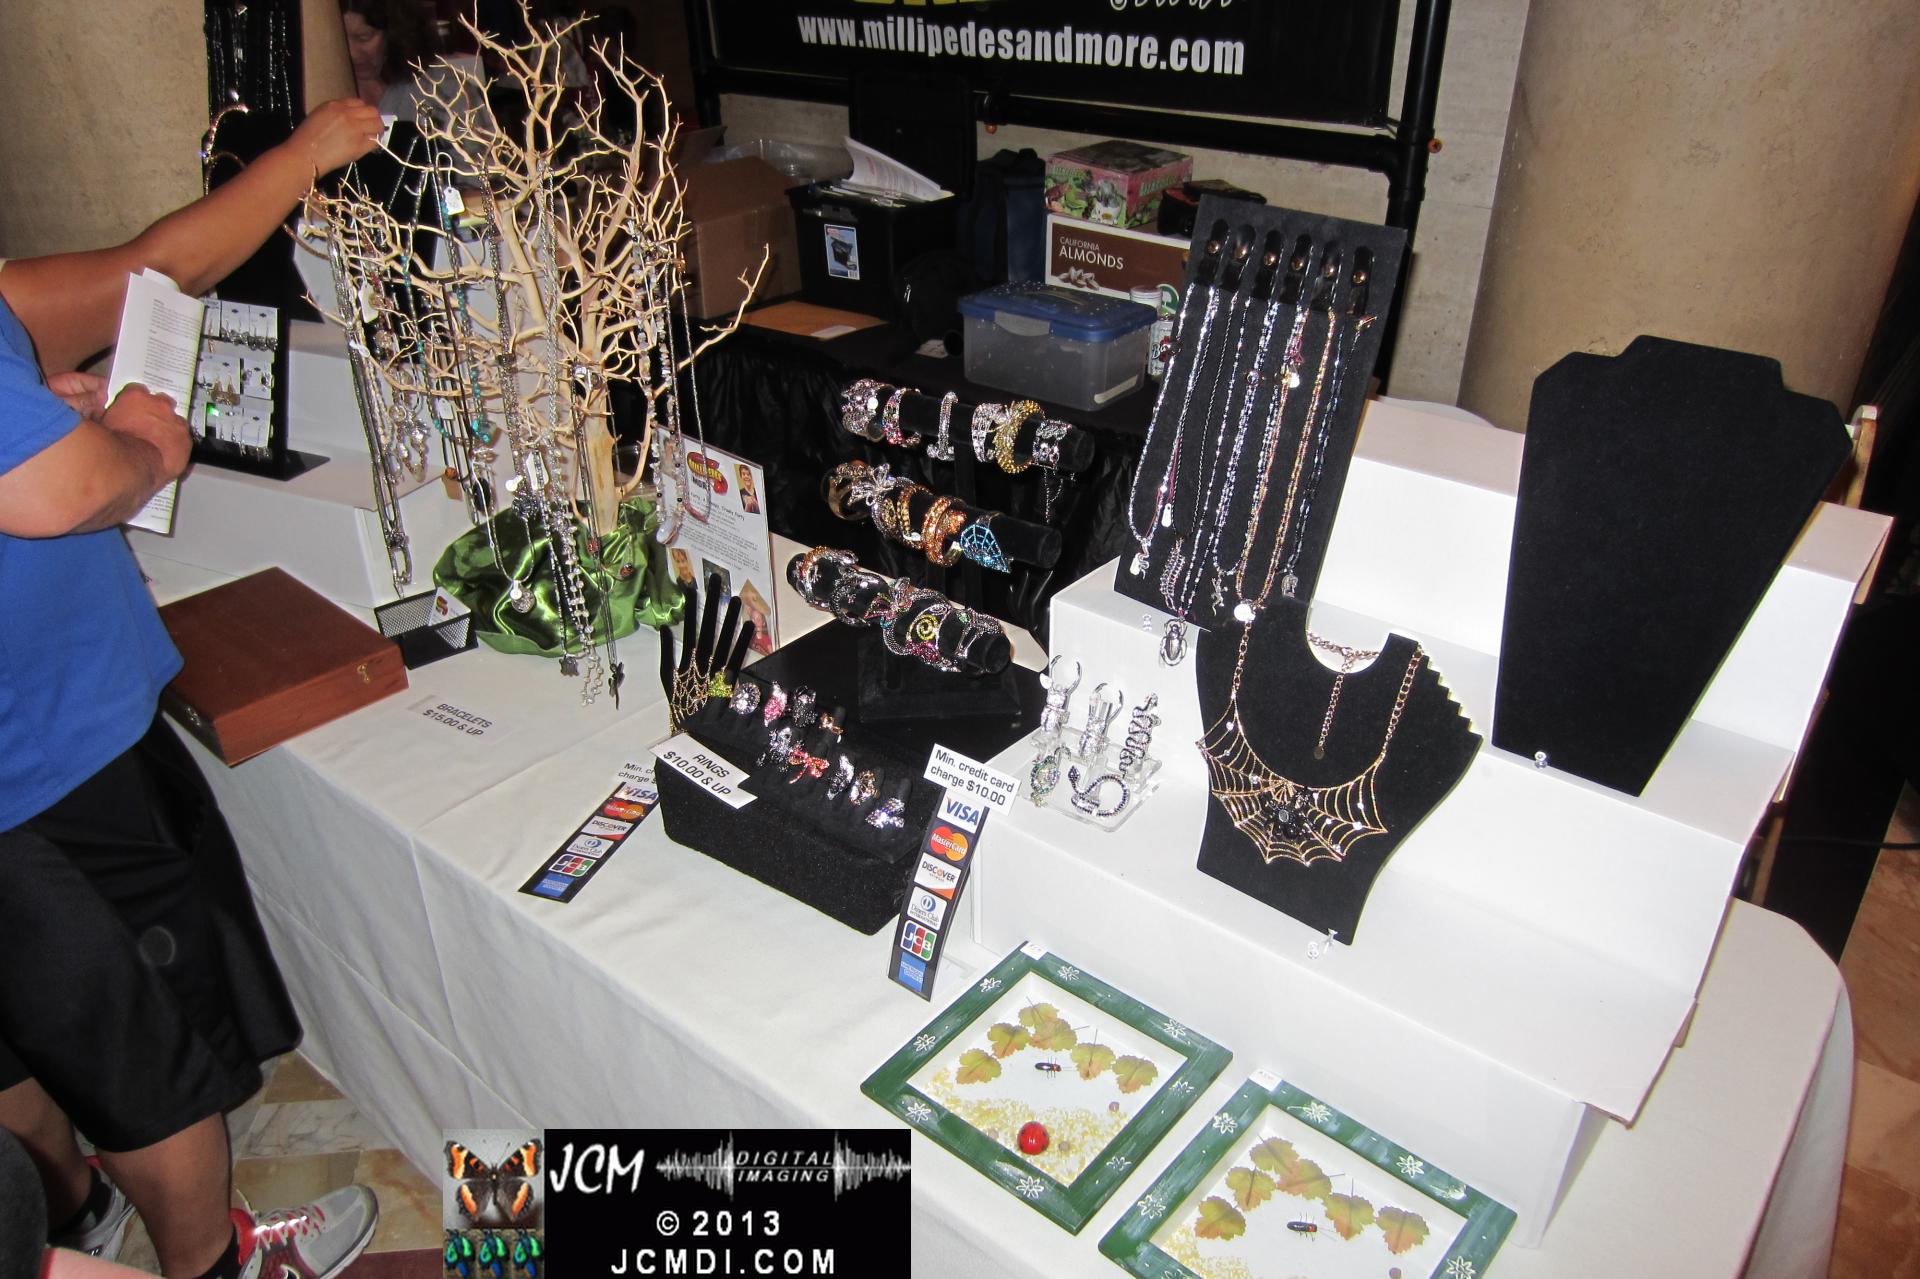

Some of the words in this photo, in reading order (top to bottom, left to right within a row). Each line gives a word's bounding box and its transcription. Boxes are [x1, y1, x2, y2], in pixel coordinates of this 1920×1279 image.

[797, 14, 1246, 76] www.millipedesandmore.com
[1059, 236, 1100, 251] CALIFORNIA
[1058, 245, 1125, 270] ALMONDS
[423, 709, 459, 727] $15.00
[457, 723, 467, 731] &
[466, 727, 484, 736] UP
[436, 703, 493, 729] BRACELETS
[618, 771, 650, 783] charge
[623, 762, 643, 773] Min.
[663, 750, 703, 780] $10.00
[700, 776, 714, 787] &
[711, 782, 732, 797] UP
[692, 753, 731, 779] RINGS
[935, 749, 957, 769] Min.
[958, 761, 990, 783] credit
[990, 773, 1015, 793] card
[624, 786, 659, 800] VISA
[930, 764, 965, 789] charge
[965, 779, 1006, 806] $10.00
[946, 797, 980, 826] VISA
[931, 833, 968, 855] MasterCard
[921, 860, 956, 882] DISCOVER
